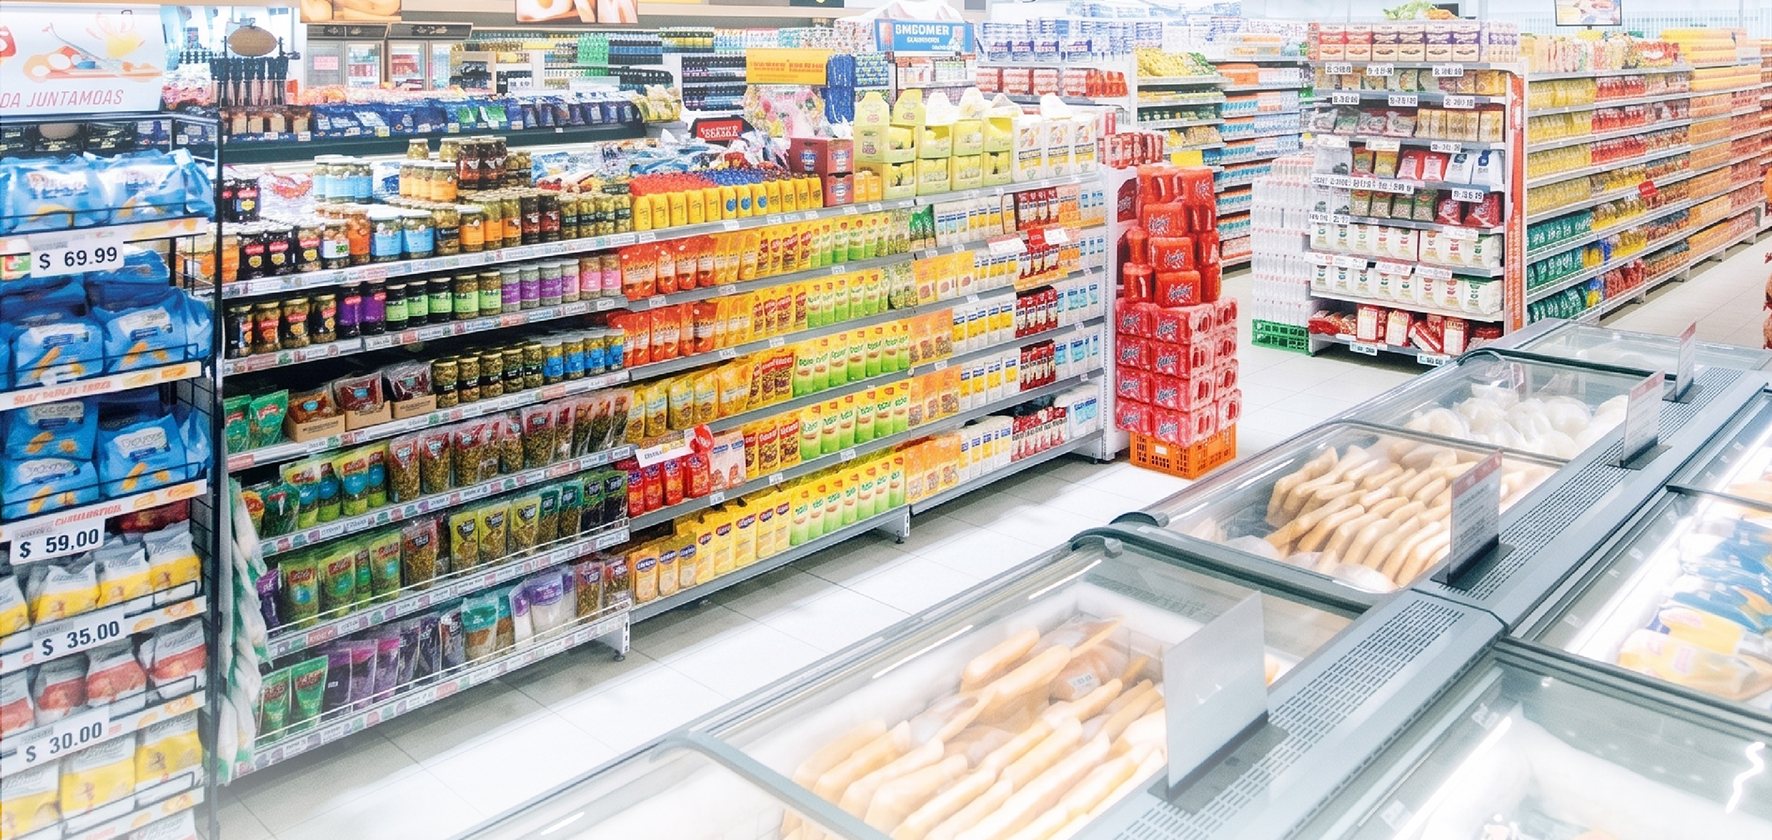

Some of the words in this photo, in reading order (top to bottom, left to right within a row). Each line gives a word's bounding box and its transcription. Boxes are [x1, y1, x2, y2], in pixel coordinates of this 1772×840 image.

[39, 253, 51, 270] $
[64, 246, 117, 267] 69.99
[20, 541, 31, 559] $
[49, 721, 102, 754] 30.00
